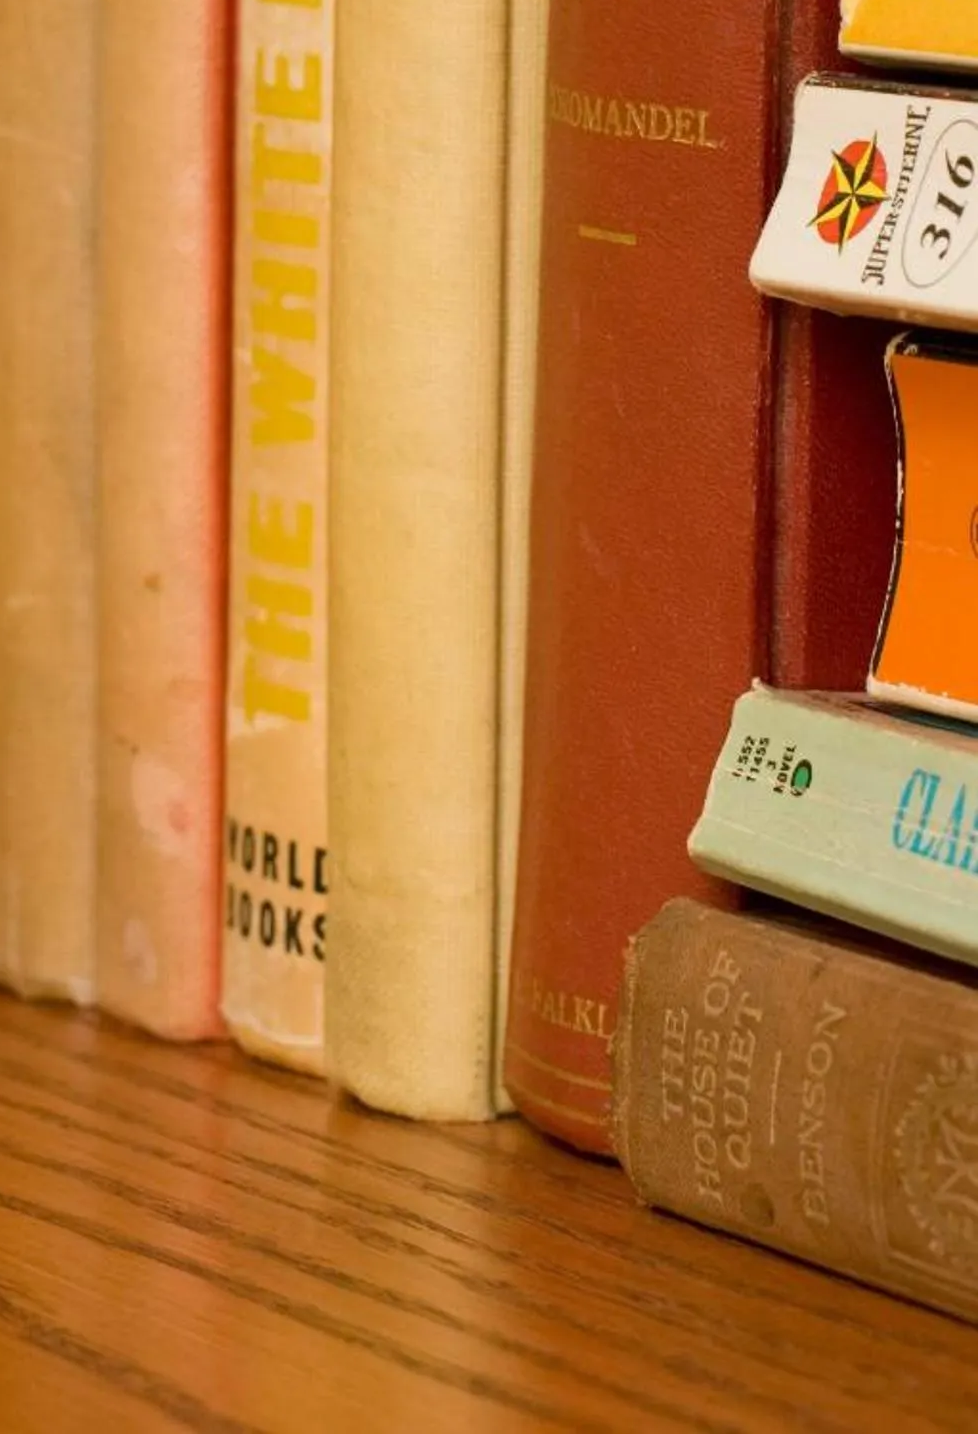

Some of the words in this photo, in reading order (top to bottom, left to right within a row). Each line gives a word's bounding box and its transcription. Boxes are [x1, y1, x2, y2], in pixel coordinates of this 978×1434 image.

[249, 46, 324, 449] WHITE
[919, 147, 976, 261] 316
[242, 489, 315, 730] THE
[662, 1006, 690, 1124] THE
[703, 949, 742, 1019] OF
[689, 1027, 724, 1209] HOUSE
[722, 990, 765, 1172] QUIET
[799, 999, 848, 1229] BENSON
